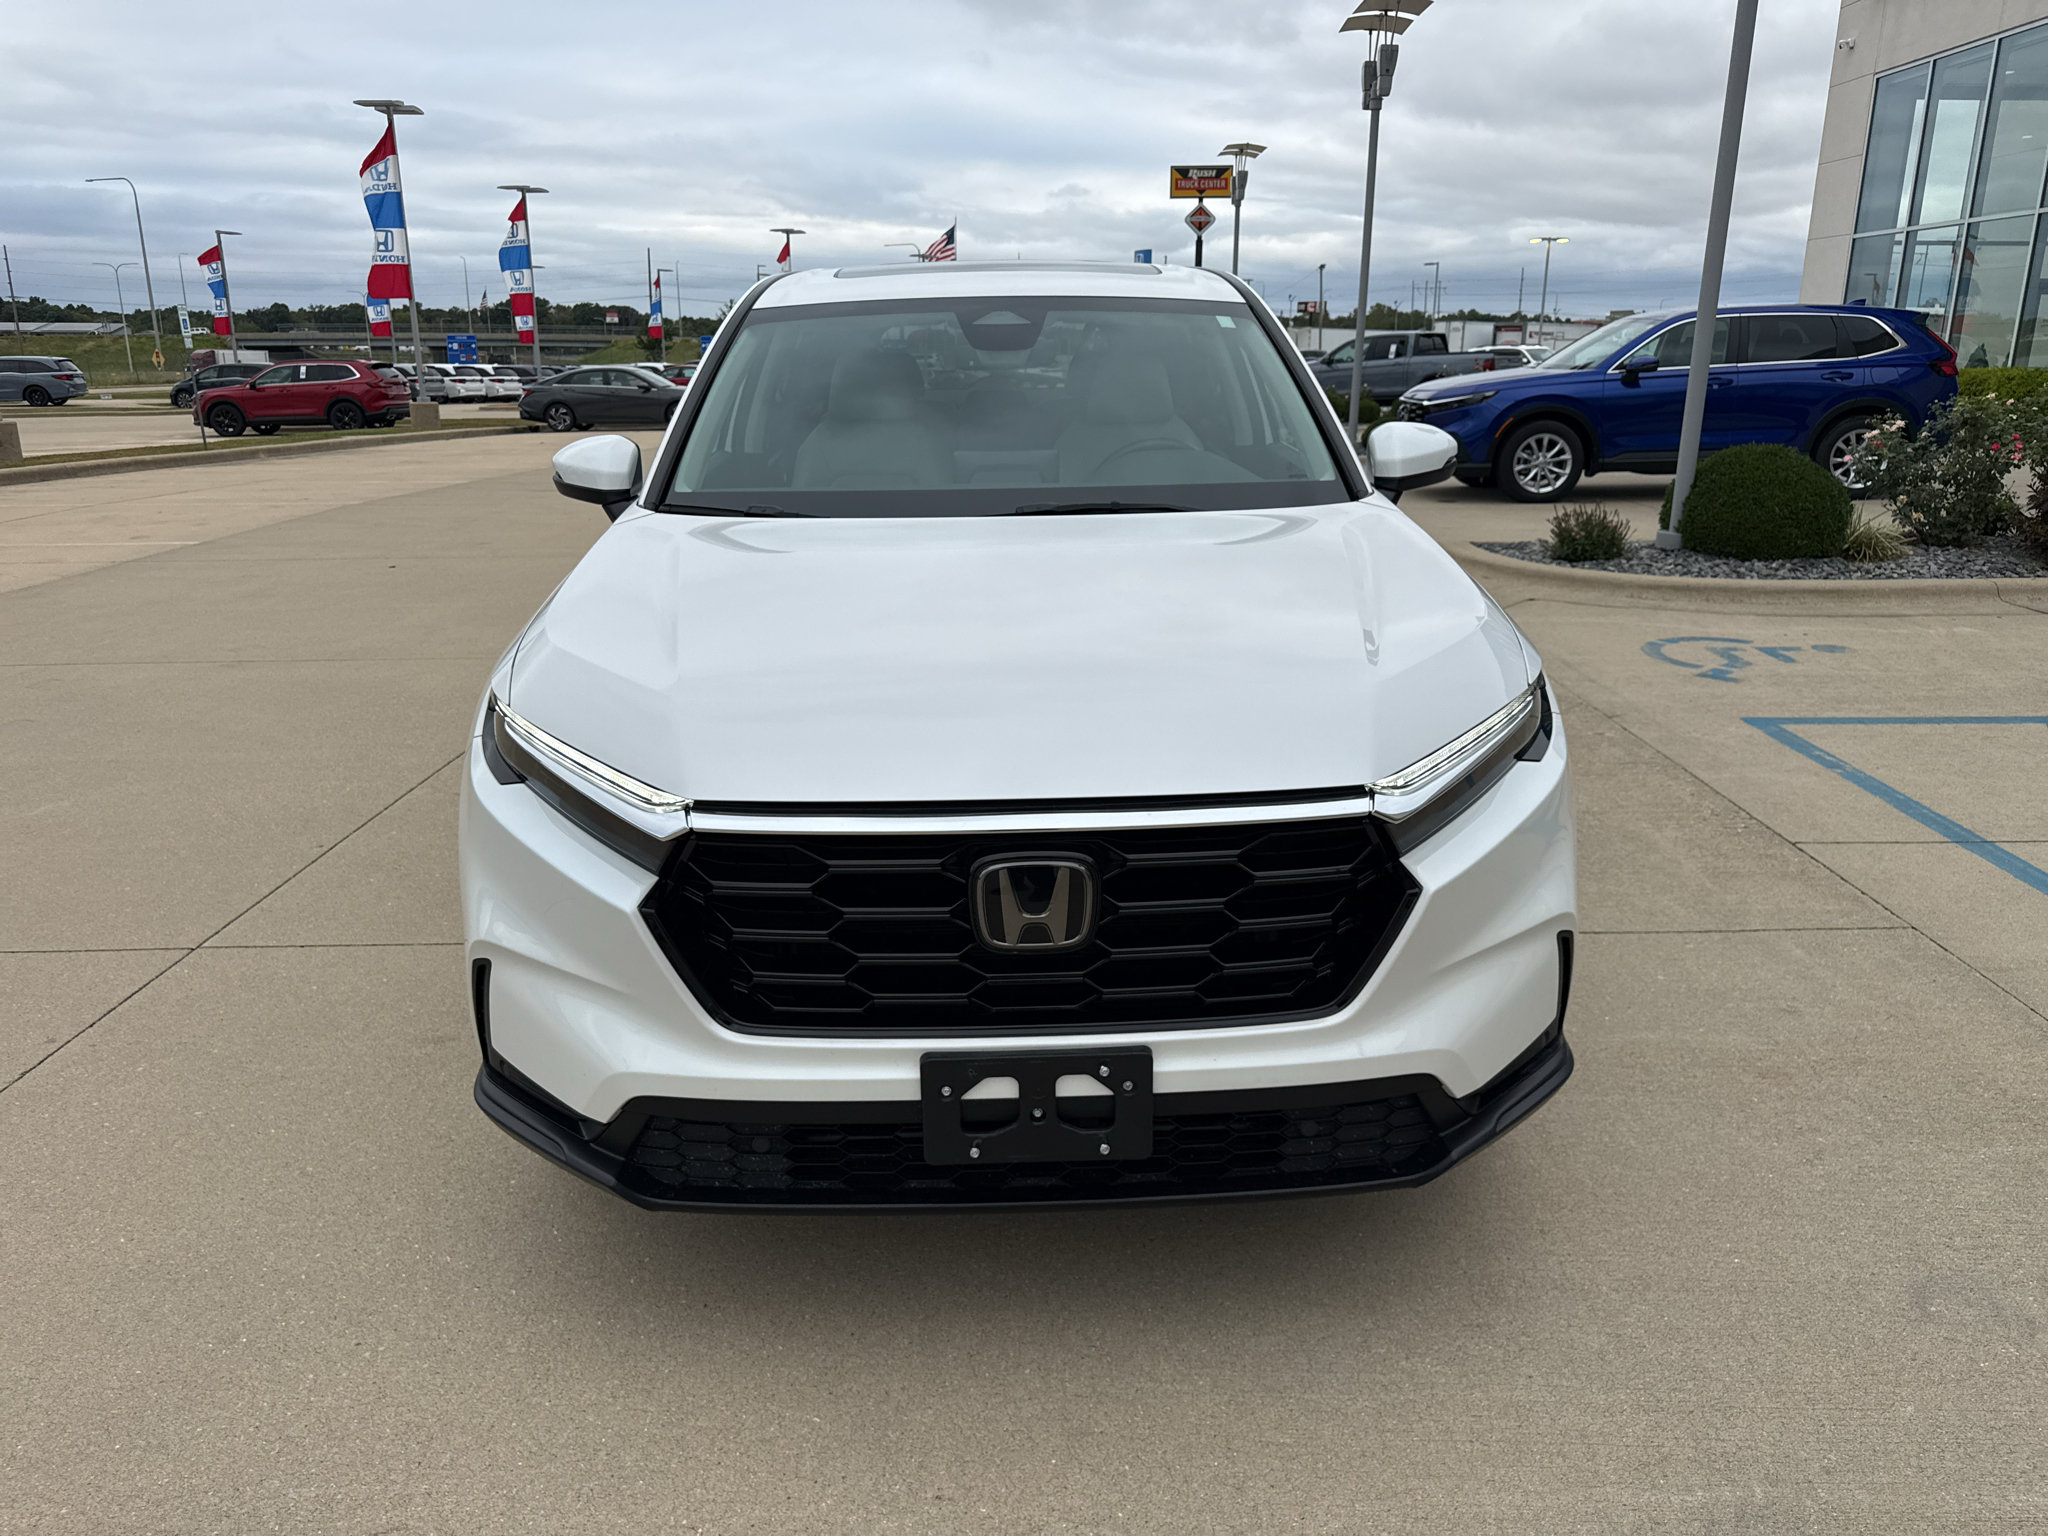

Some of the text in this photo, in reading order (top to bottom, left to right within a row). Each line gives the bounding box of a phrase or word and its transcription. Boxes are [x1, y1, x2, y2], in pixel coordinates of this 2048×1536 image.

[1187, 168, 1217, 179] RUSH
[1177, 179, 1226, 189] TRUCK CENTER
